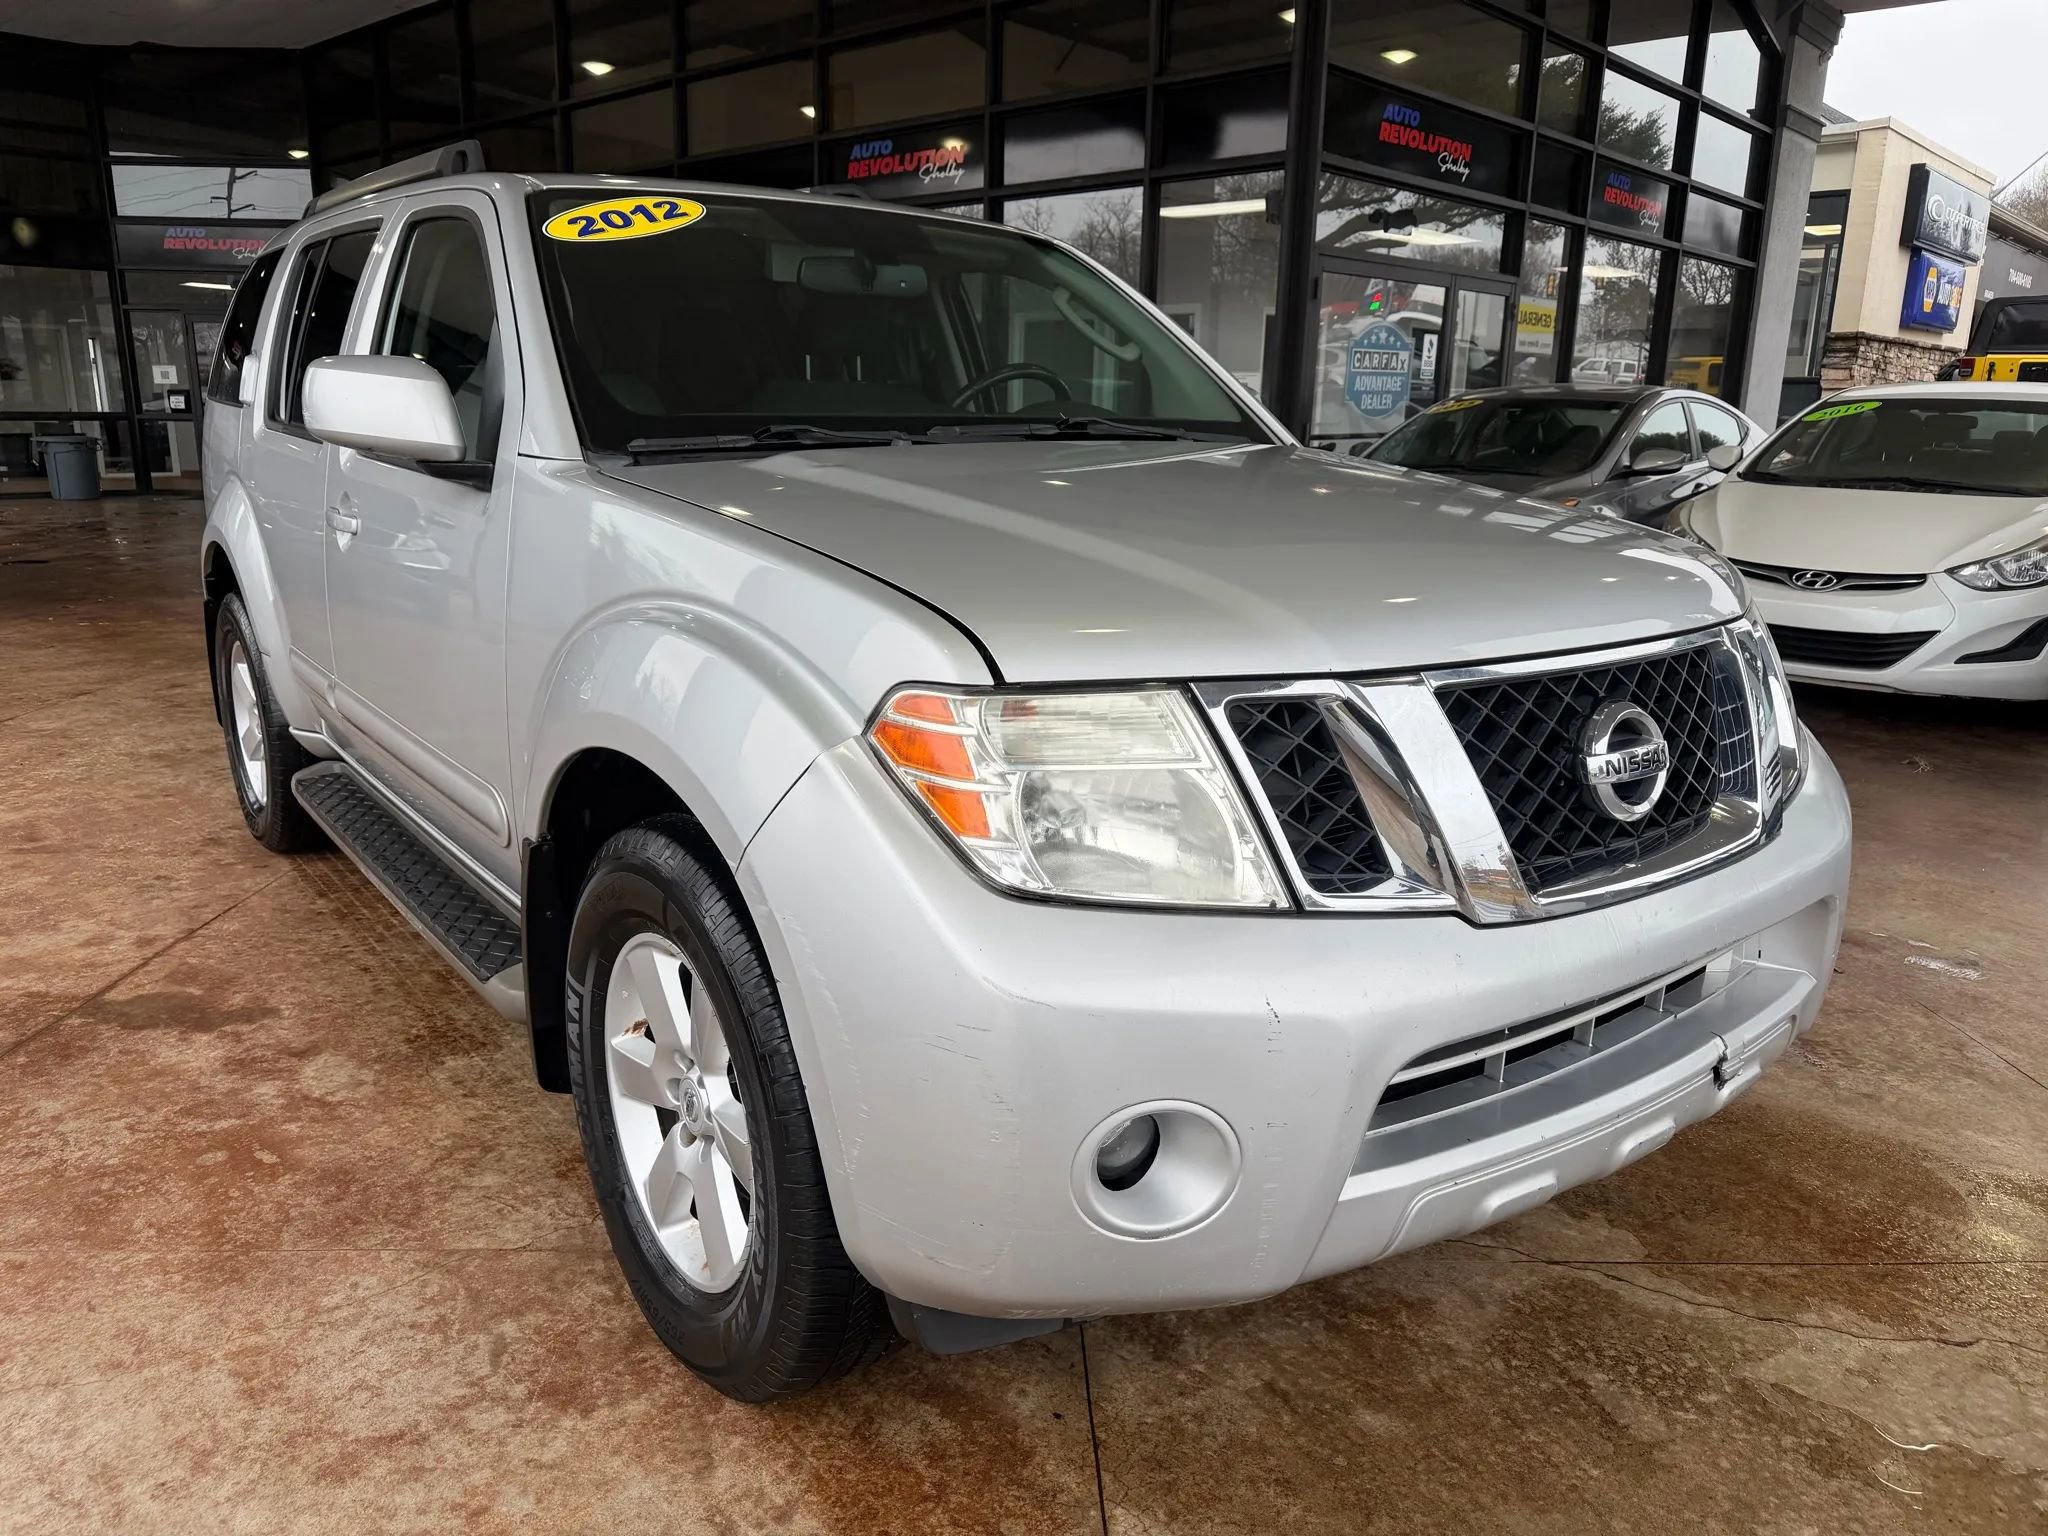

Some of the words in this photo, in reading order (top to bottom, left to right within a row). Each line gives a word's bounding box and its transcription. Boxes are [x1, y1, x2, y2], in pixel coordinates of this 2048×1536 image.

[1383, 103, 1421, 127] AUTO
[850, 139, 893, 160] AUTO
[1379, 121, 1473, 162] REVOLUTION
[848, 145, 965, 179] REVOLUTION
[919, 160, 966, 184] Shelby
[1438, 152, 1471, 183] Shelby
[1608, 172, 1631, 190] AUTO
[1604, 186, 1662, 217] REVOLUTION
[568, 201, 691, 237] 2012
[165, 227, 206, 238] AUTO
[1354, 351, 1408, 372] CARFAX
[1354, 376, 1402, 392] ADVANTAGE
[1361, 394, 1393, 410] DEALER
[1815, 405, 1865, 420] 2016
[1604, 743, 1667, 777] NISSAN
